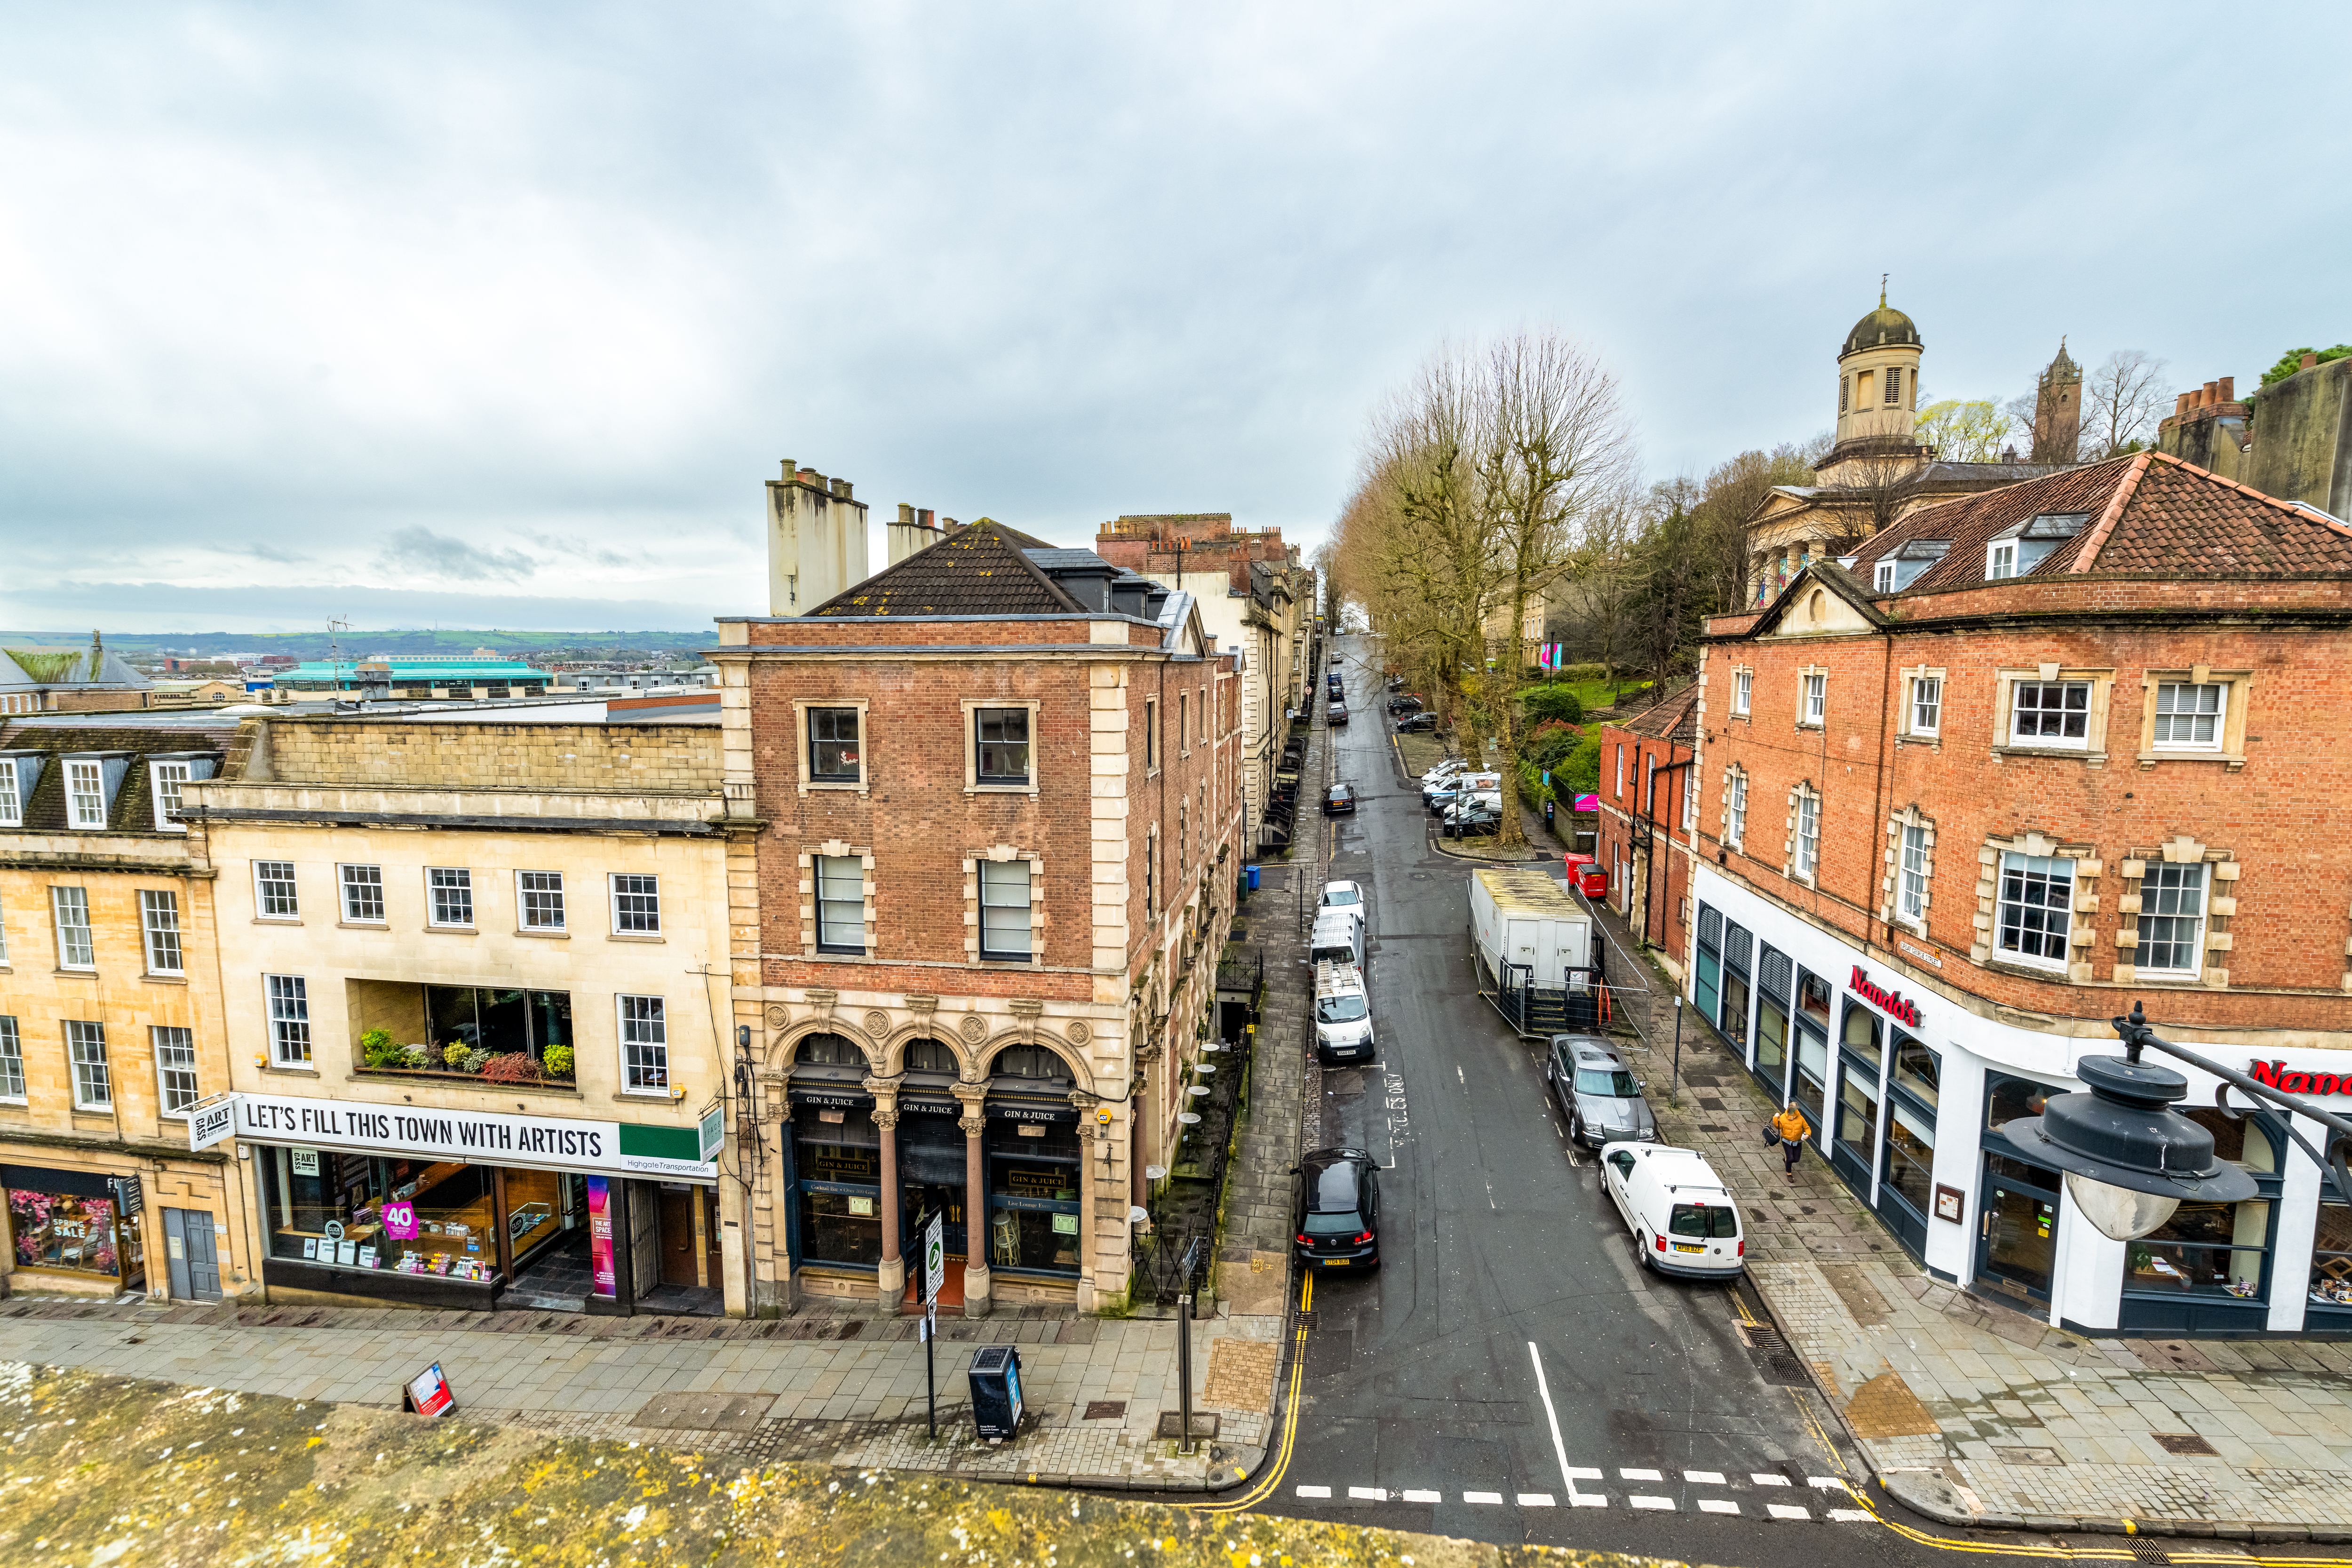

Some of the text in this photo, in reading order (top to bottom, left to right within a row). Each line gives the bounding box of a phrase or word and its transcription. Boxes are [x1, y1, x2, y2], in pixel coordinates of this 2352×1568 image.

[1849, 965, 1915, 1027] Nando's
[1388, 1074, 1405, 1094] ONLY
[2251, 1059, 2352, 1096] Nan
[196, 1107, 229, 1141] CASS ART
[247, 1104, 602, 1157] LET'S FILL THIS TOWN WITH ARTISTS
[302, 1153, 316, 1163] ART
[53, 1218, 84, 1228] SPRING
[387, 1207, 412, 1226] 40
[55, 1226, 86, 1238] SALE
[928, 1236, 936, 1249] Clean
[929, 1265, 940, 1284] ZONE
[927, 1282, 937, 1297] Charges
[414, 1381, 425, 1392] CASS
